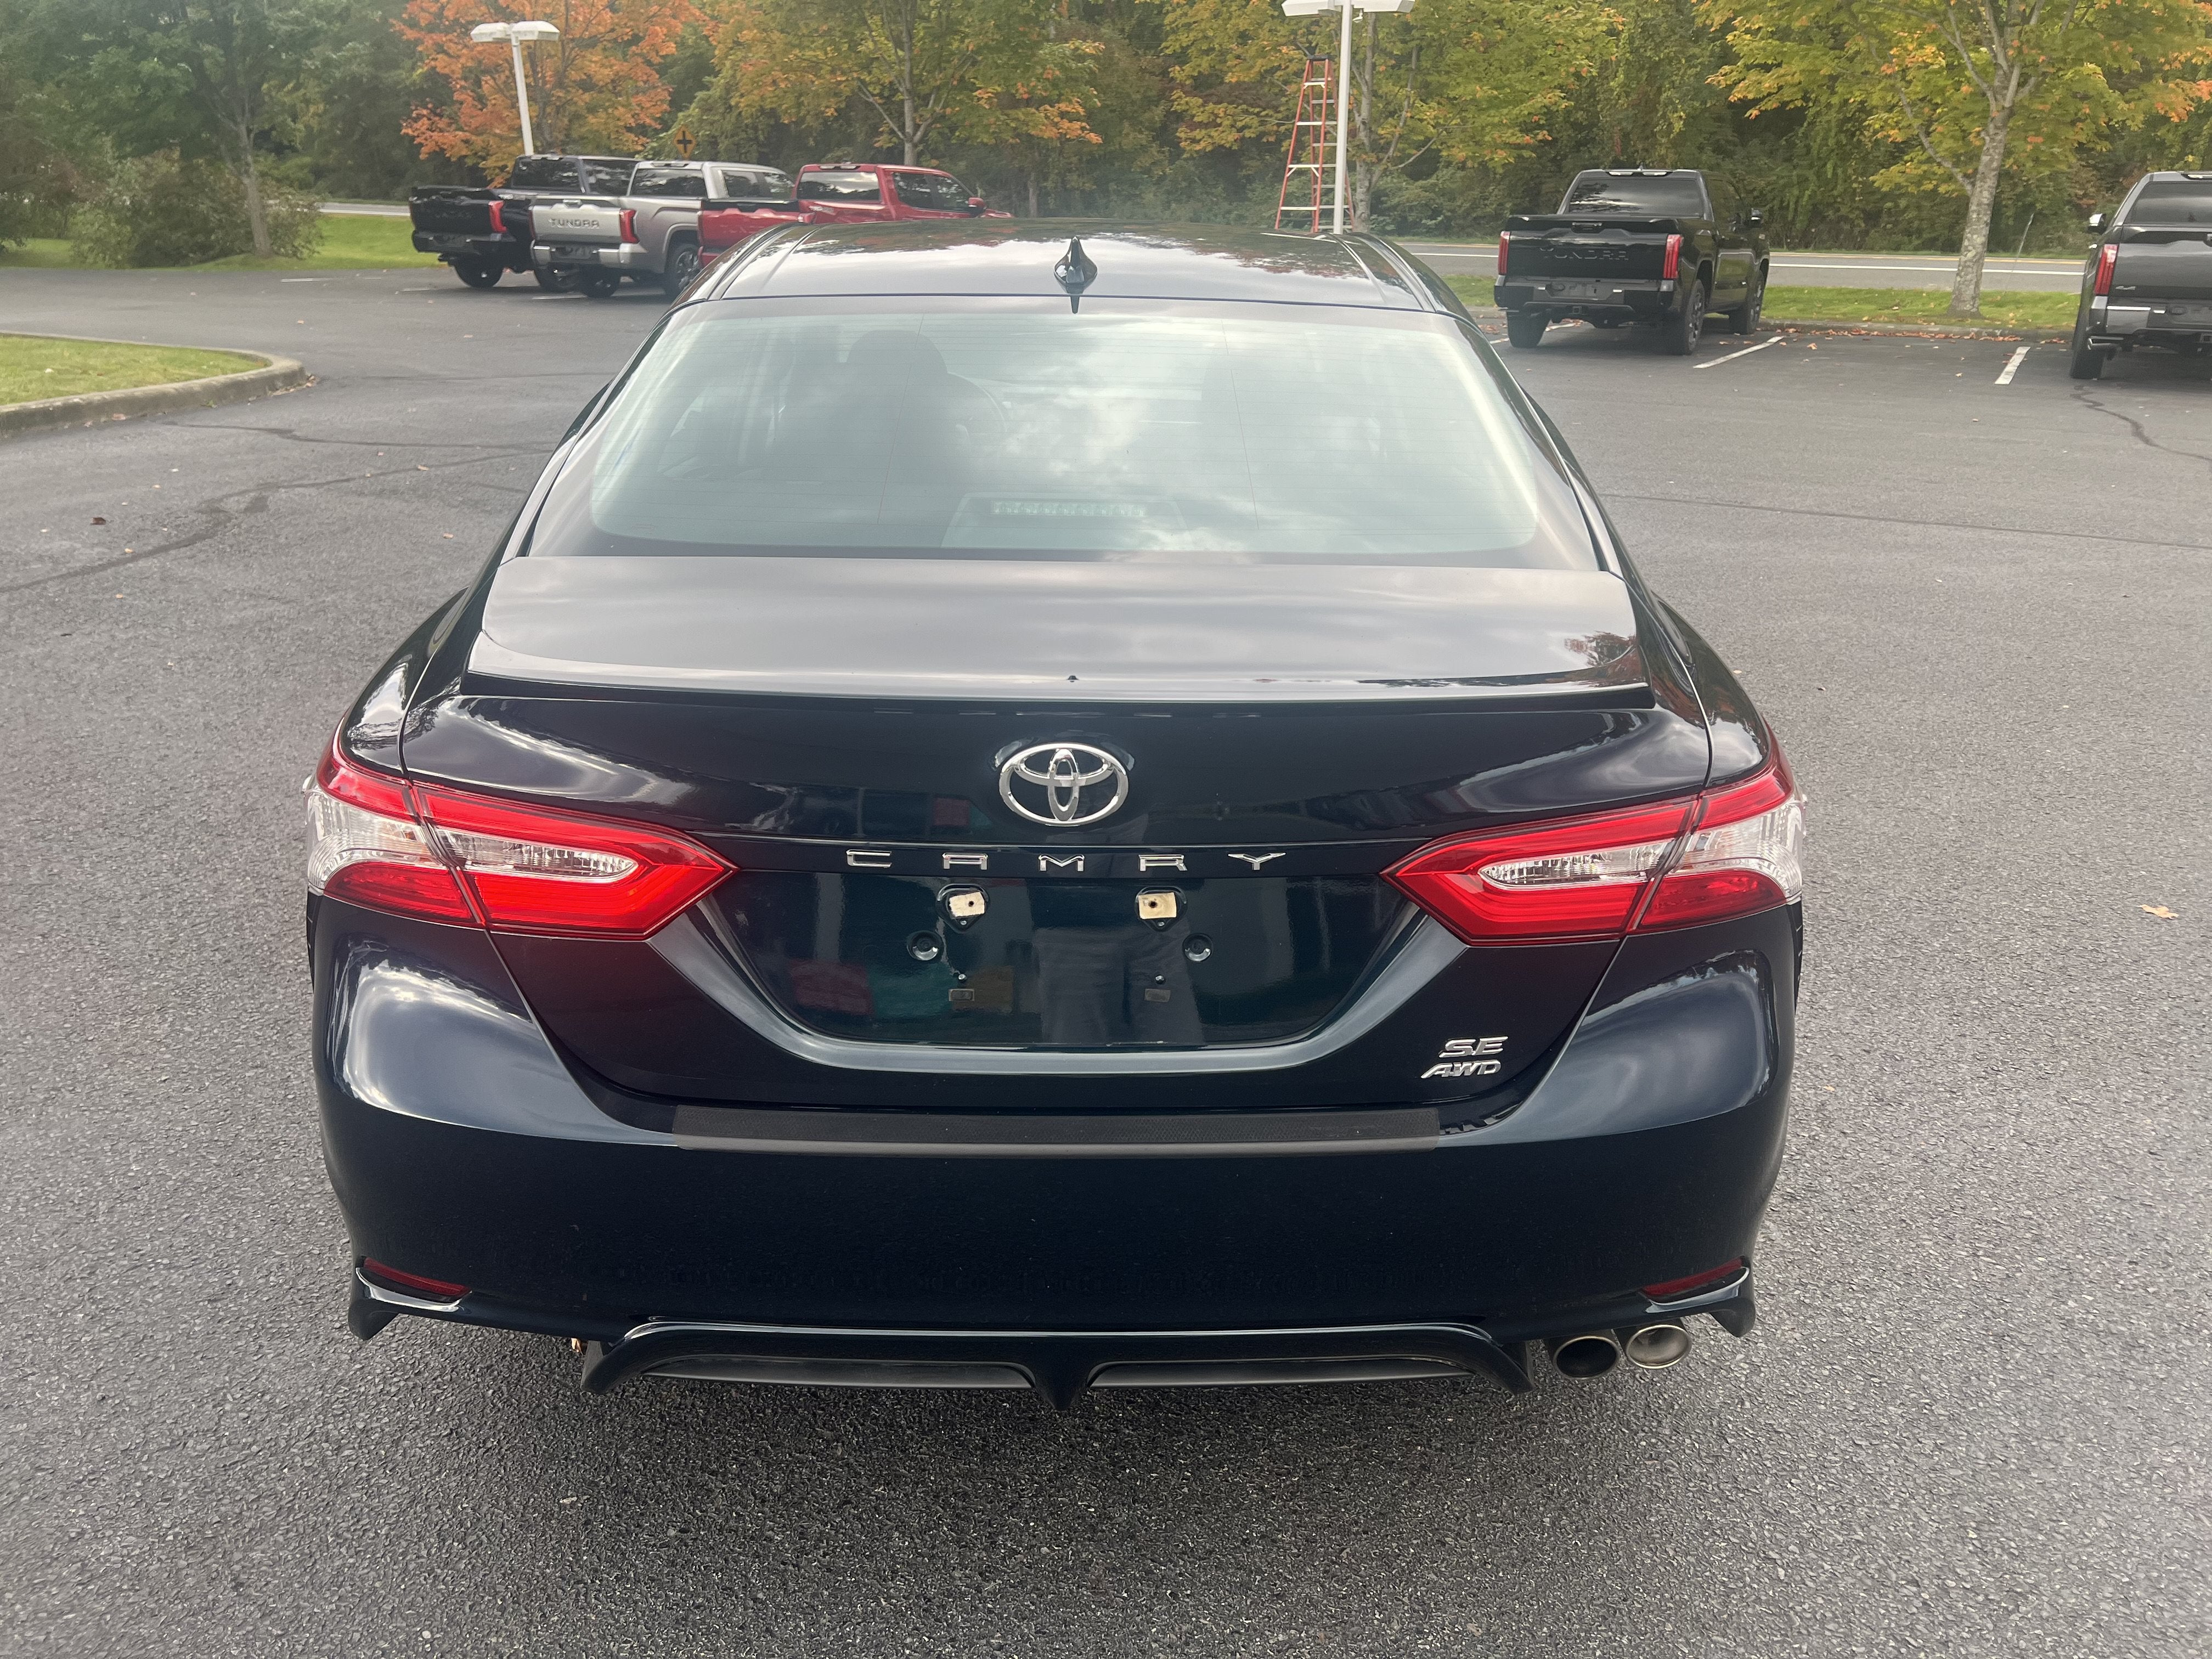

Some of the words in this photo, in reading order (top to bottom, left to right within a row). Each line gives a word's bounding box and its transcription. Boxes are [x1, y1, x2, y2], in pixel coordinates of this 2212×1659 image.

[549, 218, 600, 229] TUNDRA
[845, 849, 1286, 872] CAMRY
[1438, 1036, 1508, 1058] SE
[1420, 1059, 1502, 1079] AWD
